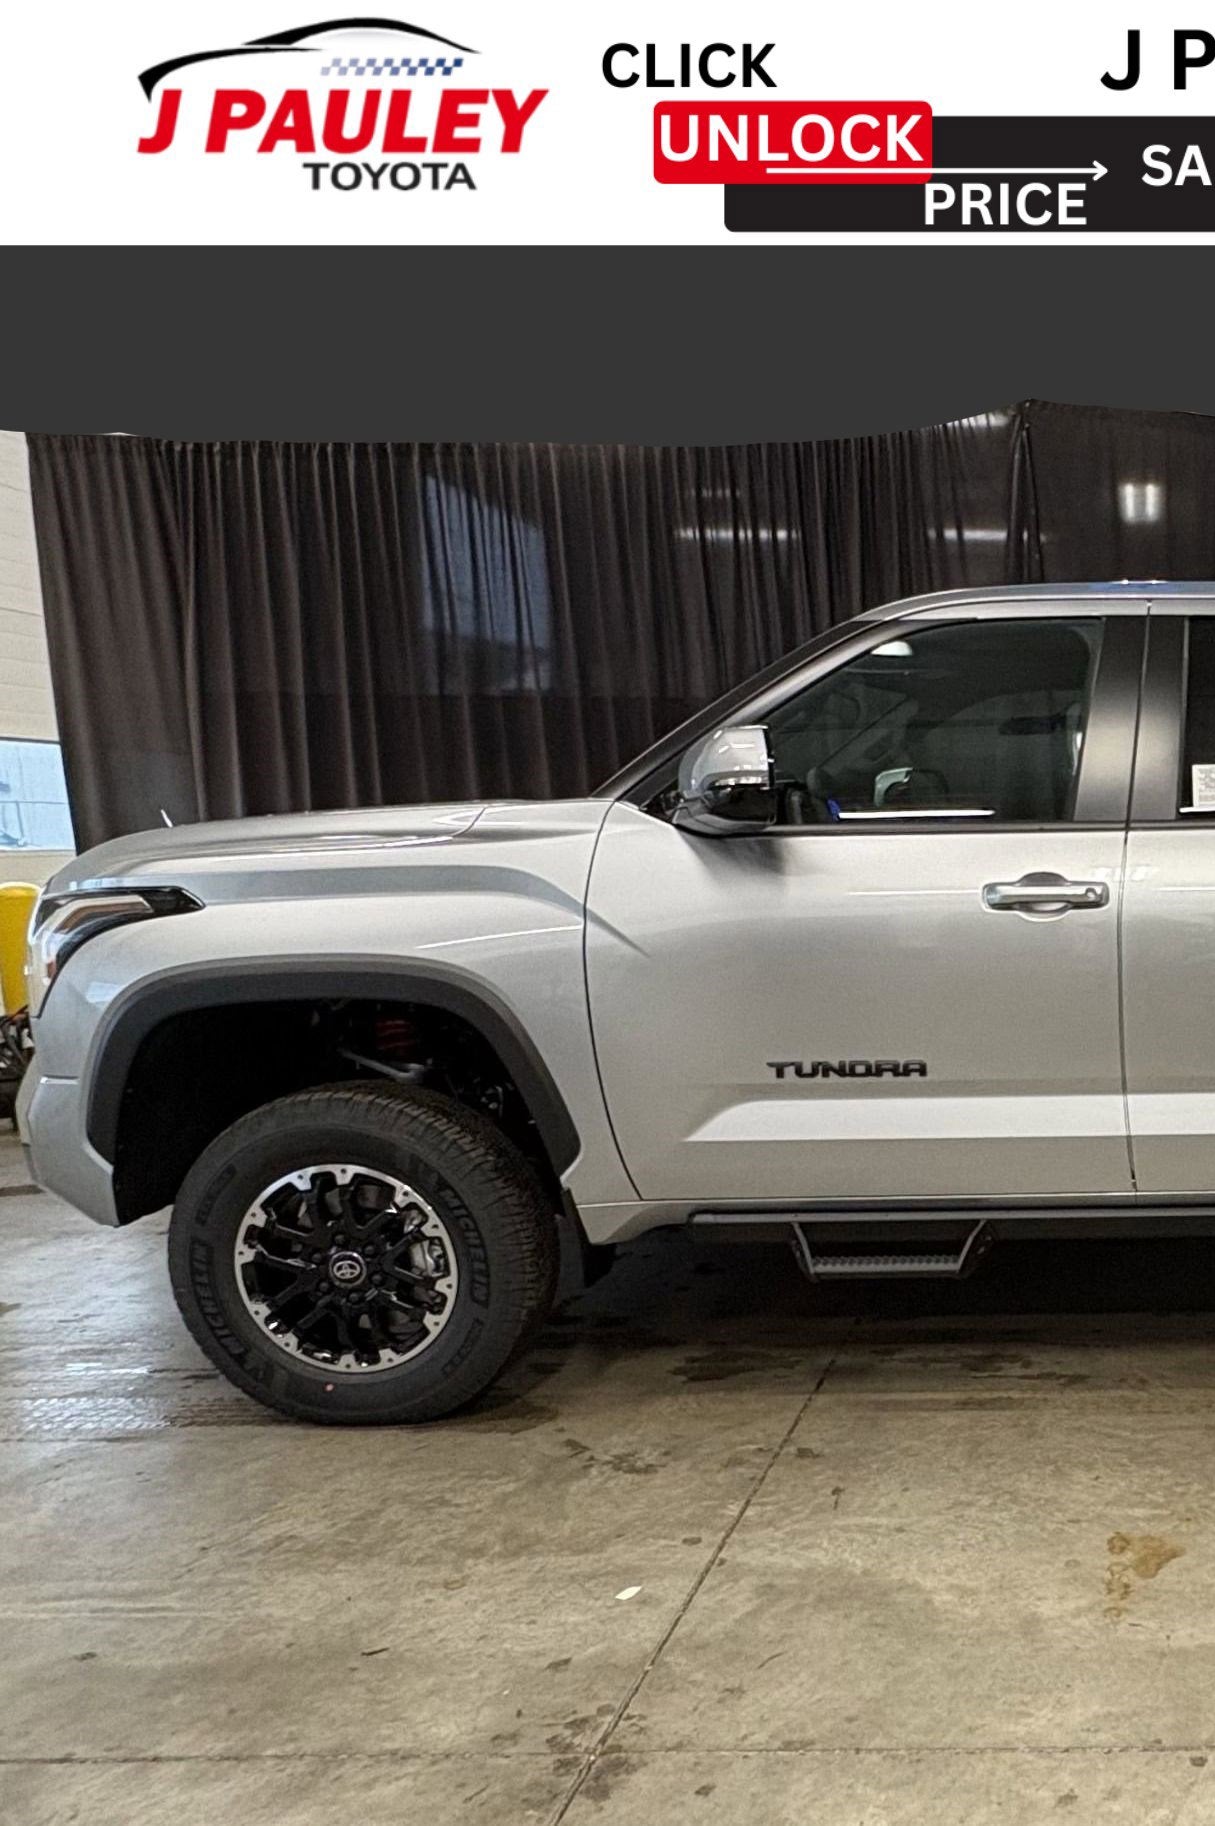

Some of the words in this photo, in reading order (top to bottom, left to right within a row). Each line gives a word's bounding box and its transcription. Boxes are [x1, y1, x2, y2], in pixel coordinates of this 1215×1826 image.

[765, 1060, 928, 1079] TUNDRA
[191, 1241, 248, 1356] MICHELIN
[441, 1187, 489, 1303] MICHELIN
